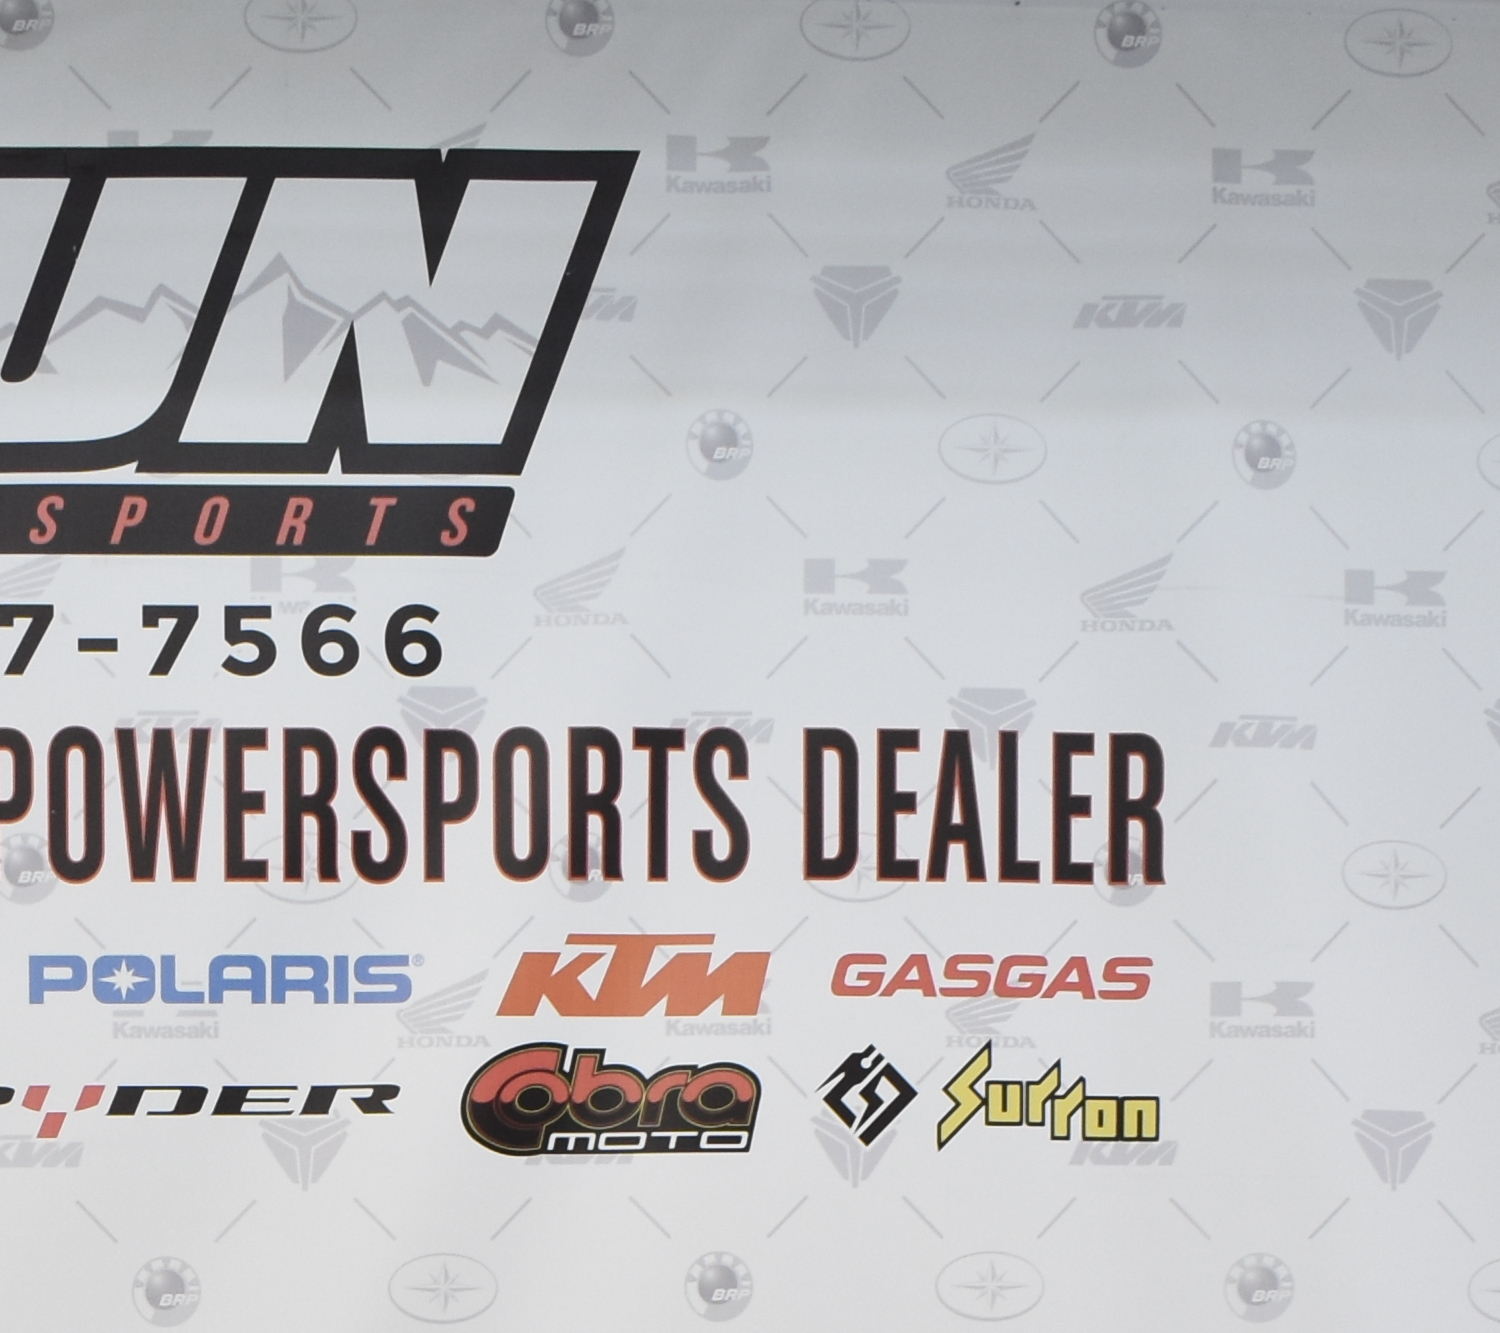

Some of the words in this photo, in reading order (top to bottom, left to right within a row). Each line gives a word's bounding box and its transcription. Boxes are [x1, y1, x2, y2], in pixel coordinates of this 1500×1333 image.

[663, 173, 773, 196] Kawasaki
[947, 194, 1038, 212] HONDA
[1210, 185, 1316, 210] Kawasaki
[1071, 294, 1188, 328] KTM
[1257, 456, 1295, 472] BRP
[801, 595, 911, 619] Kawasaki
[1342, 606, 1448, 630] Kawasaki
[533, 611, 630, 628] HONDA
[1079, 618, 1176, 632] HONDA
[1209, 713, 1321, 751] KTM
[802, 727, 1167, 887] DEALER
[28, 953, 412, 1005] POLARIS
[495, 932, 772, 1017] KTM
[831, 952, 1154, 1000] GASGAS
[110, 1018, 220, 1042] Kawasaki
[664, 1019, 772, 1037] Kawasaki
[1207, 1018, 1317, 1041] Kawasaki
[396, 1033, 493, 1049] HONDA
[945, 1036, 1037, 1050] HONDA
[462, 1043, 762, 1154] Cobra
[546, 1131, 750, 1152] MOTO
[711, 1287, 752, 1303] BRP
